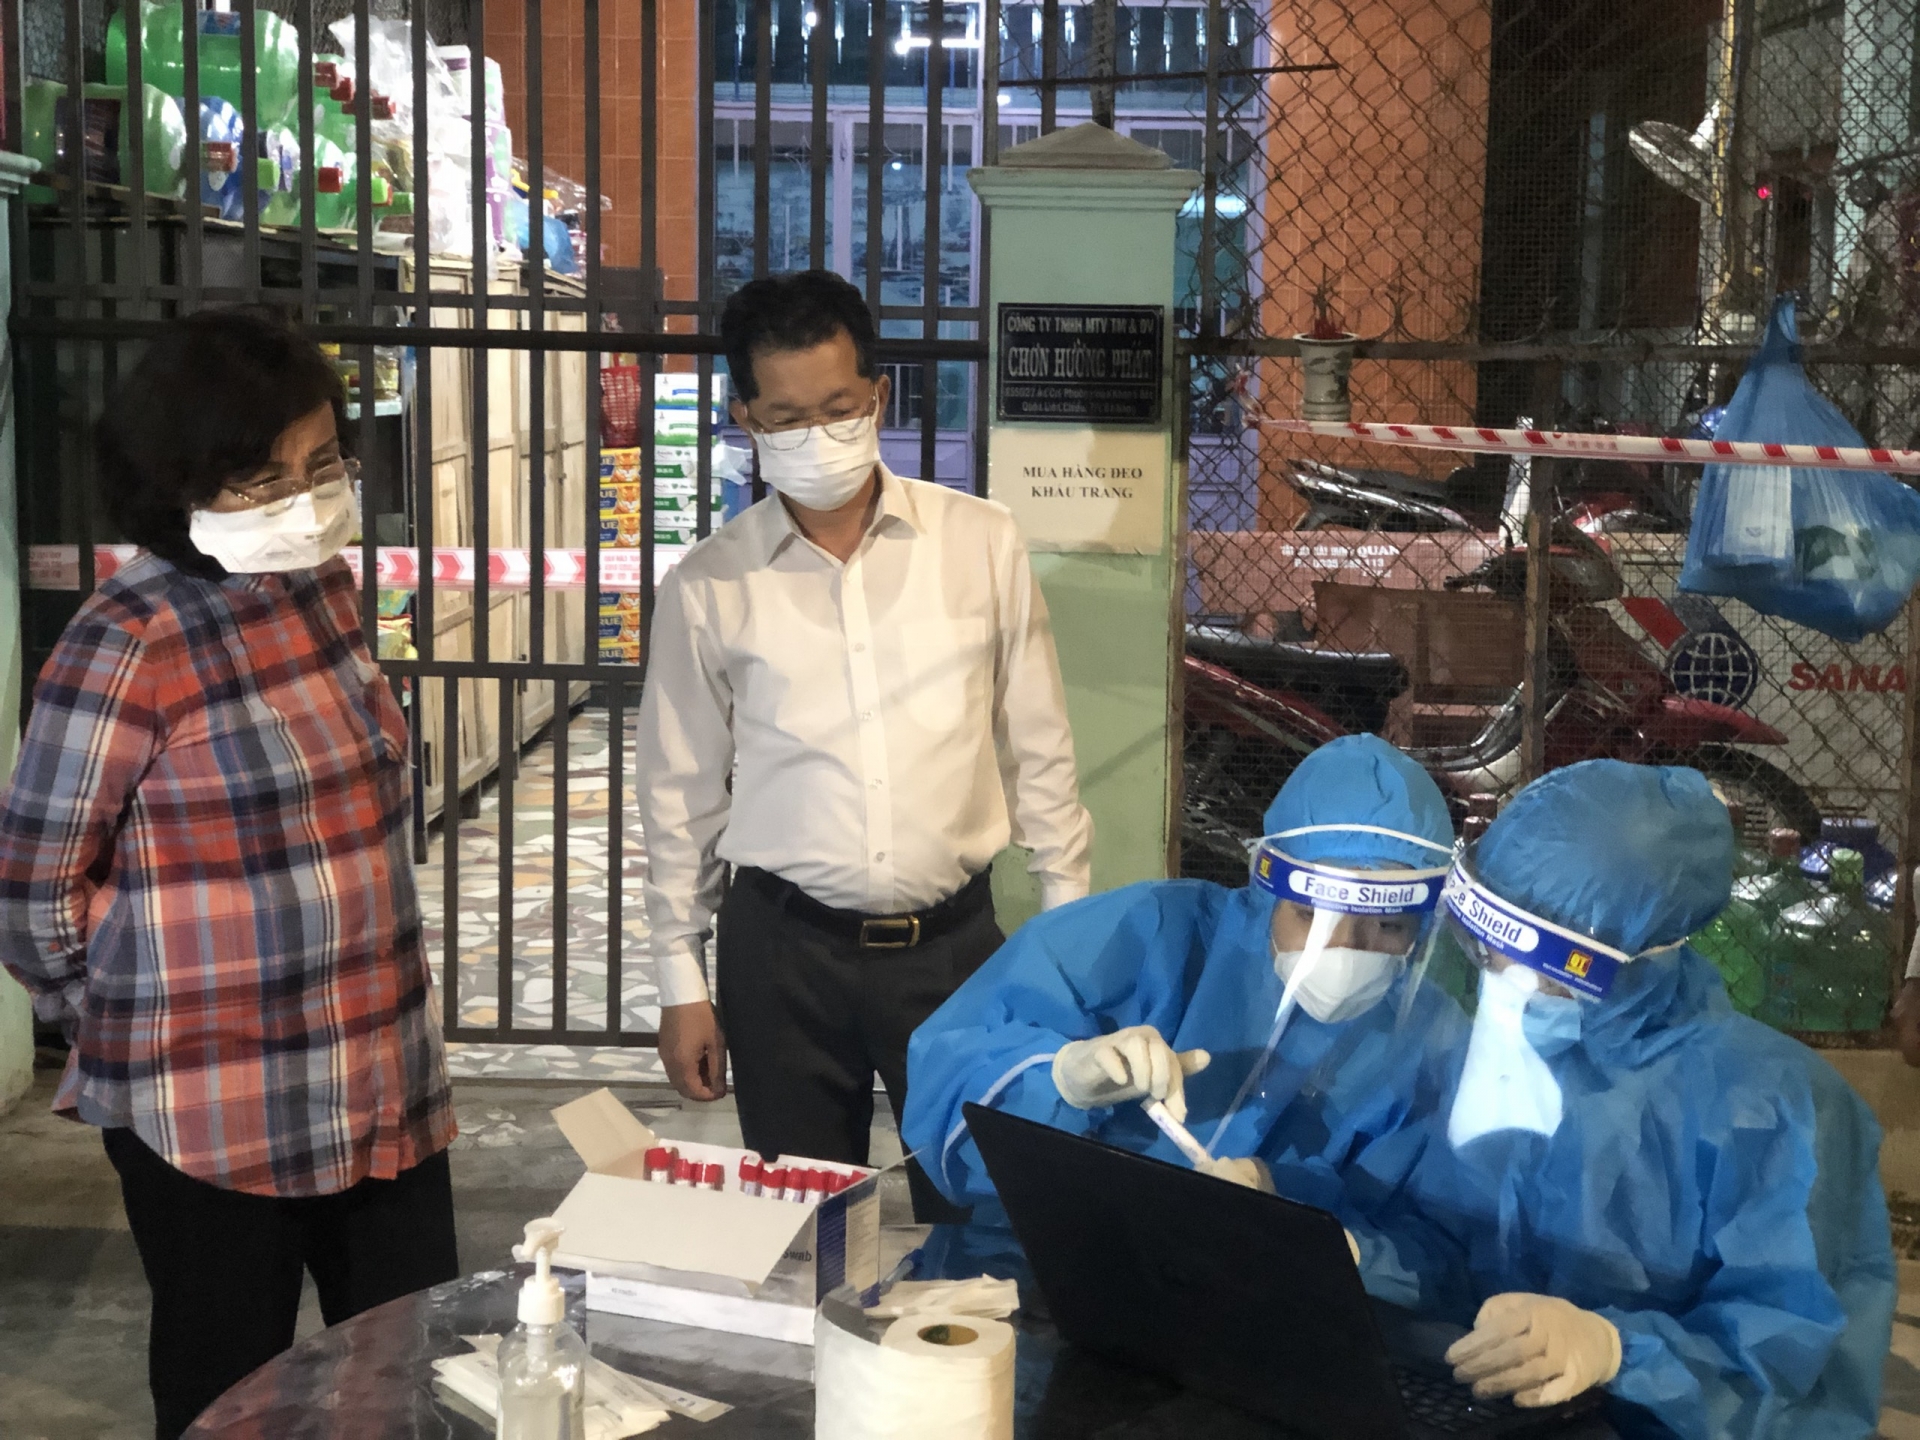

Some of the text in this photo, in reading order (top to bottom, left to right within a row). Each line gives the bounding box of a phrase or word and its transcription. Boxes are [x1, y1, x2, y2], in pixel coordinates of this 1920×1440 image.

[1038, 316, 1051, 333] TY
[1055, 317, 1083, 333] TNHH
[1085, 317, 1107, 334] MTV
[1022, 466, 1057, 479] MUA
[1062, 463, 1106, 479] HÀNG
[1079, 486, 1133, 499] TRANG
[1304, 876, 1415, 904] Face Shield
[1351, 905, 1383, 914] Isolation
[1469, 898, 1522, 944] Shield
